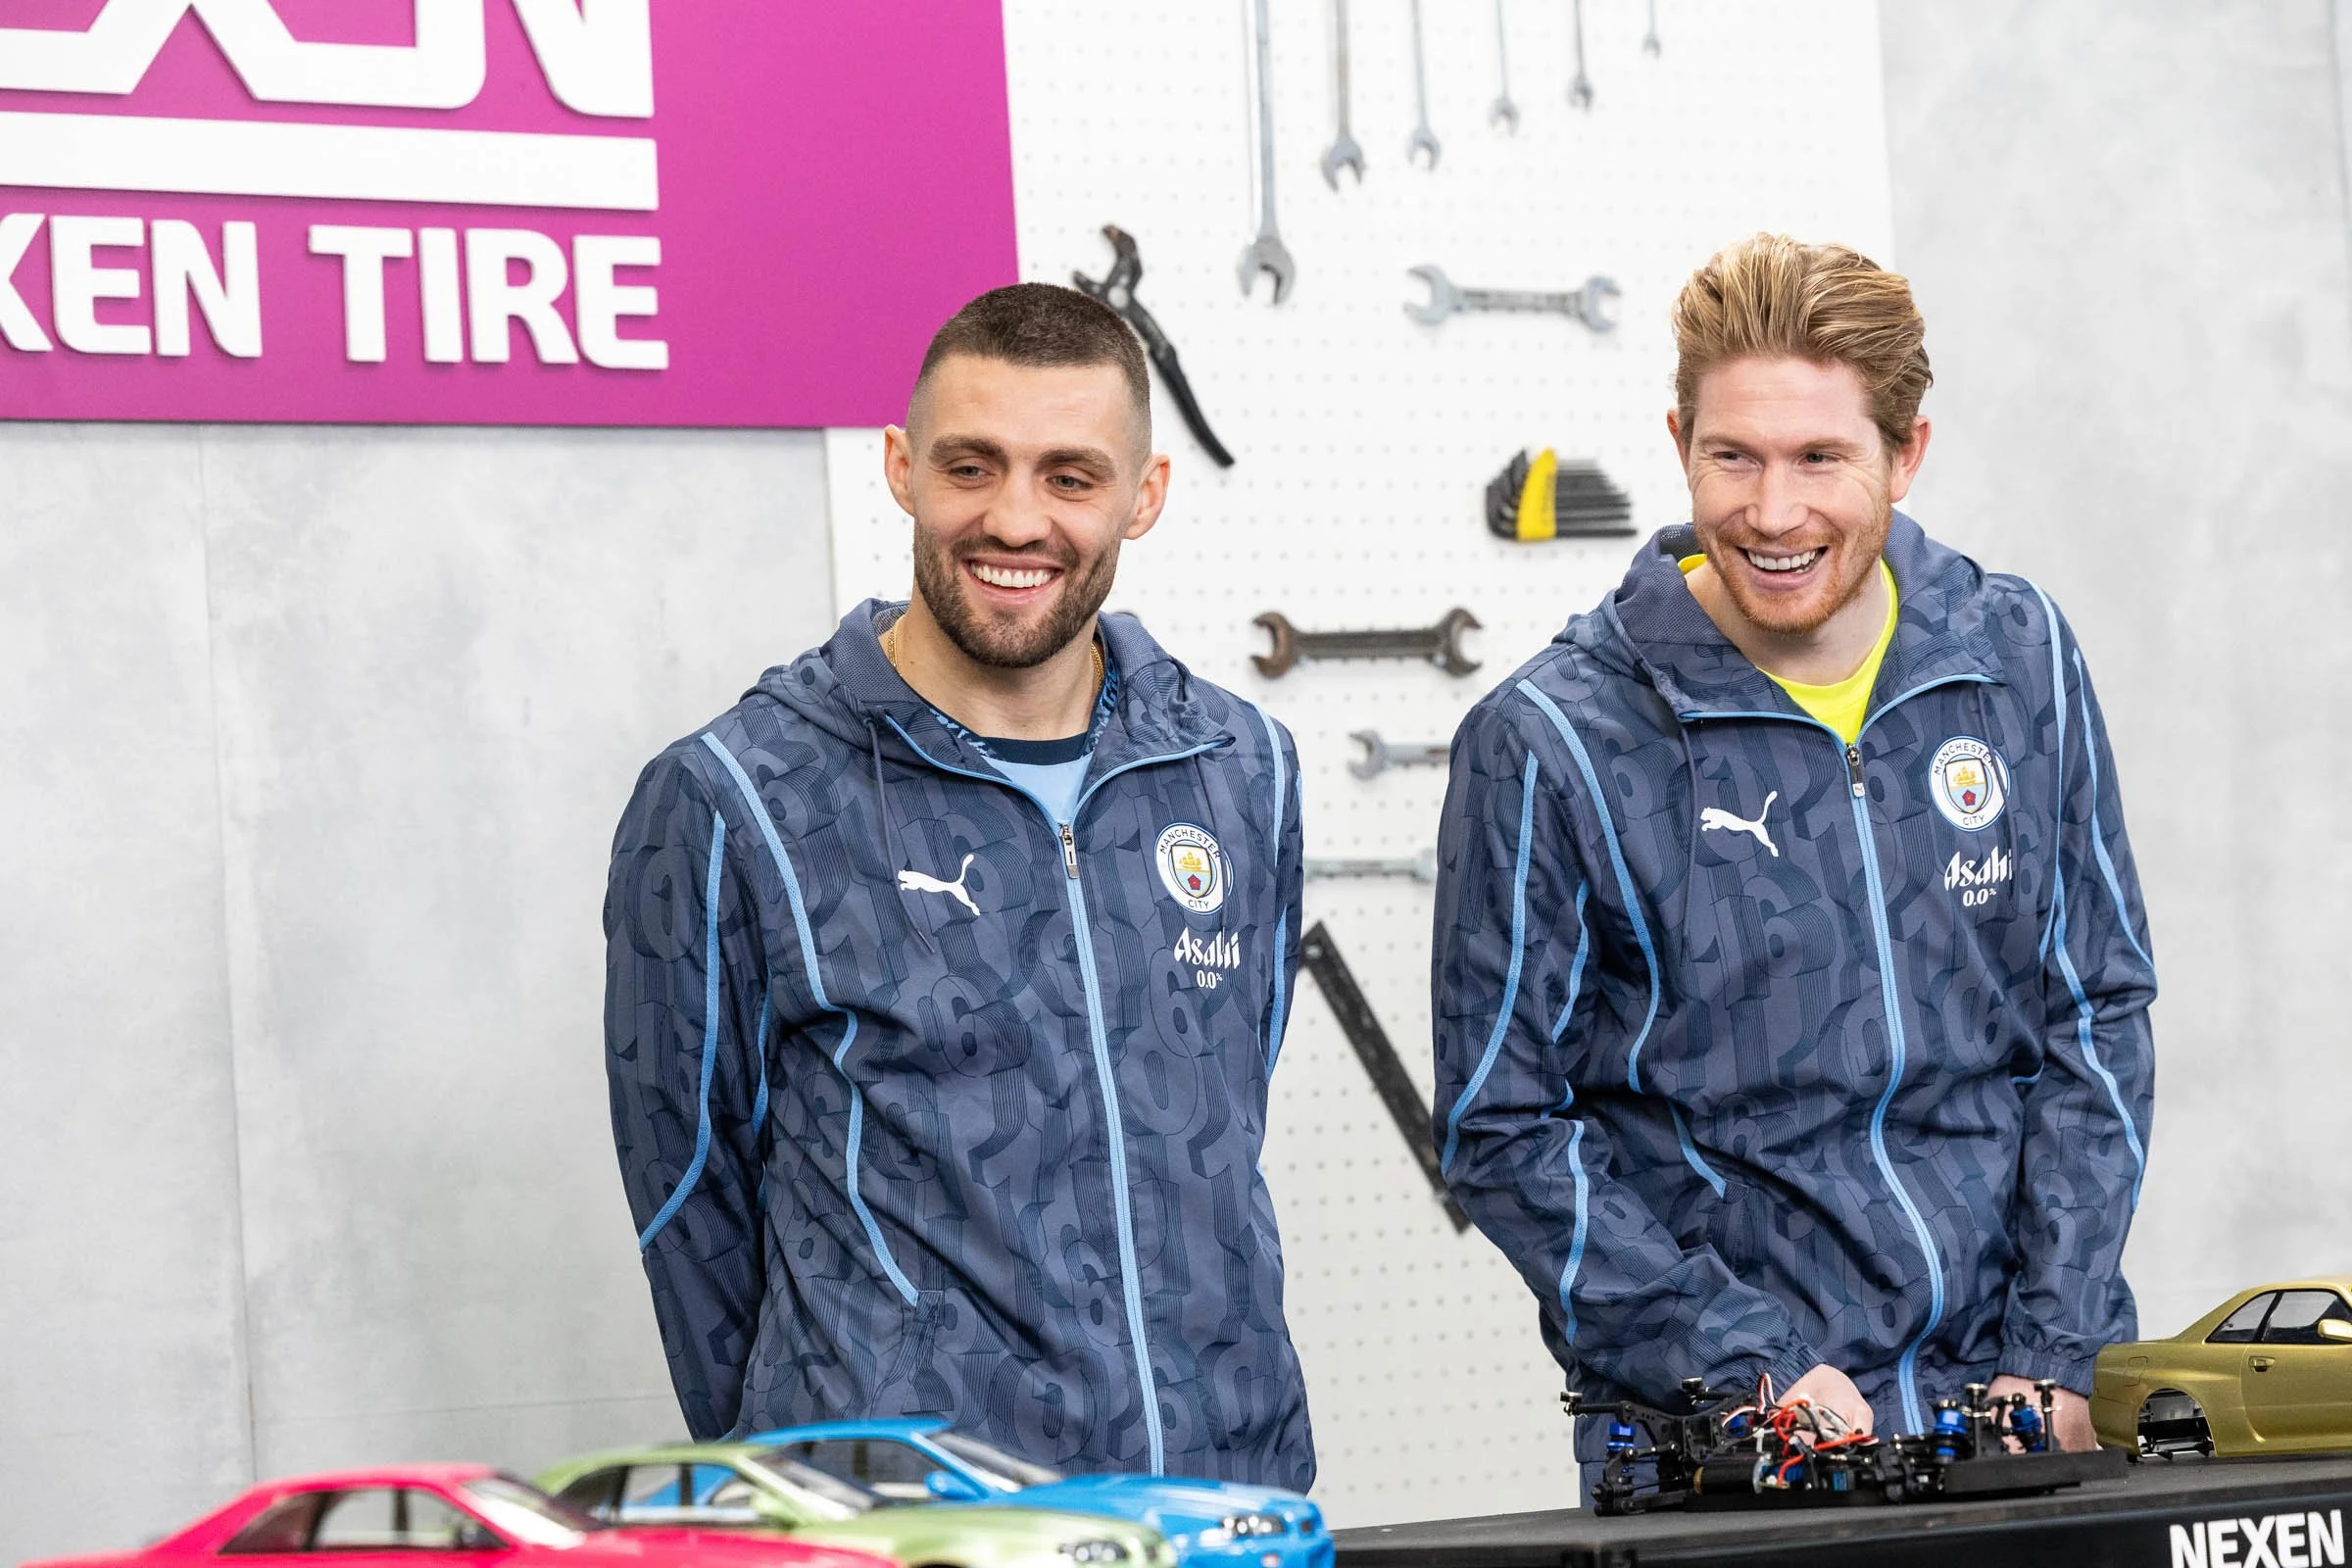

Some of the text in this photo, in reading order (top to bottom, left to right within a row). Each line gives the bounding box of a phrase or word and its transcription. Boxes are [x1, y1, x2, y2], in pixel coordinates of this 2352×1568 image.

[309, 224, 669, 369] TIRE
[1963, 814, 1984, 826] CITY
[1160, 829, 1220, 858] MANCHESTER
[1188, 899, 1209, 909] CITY
[1174, 926, 1241, 969] Asahi
[2169, 1509, 2345, 1568] NEXEN
